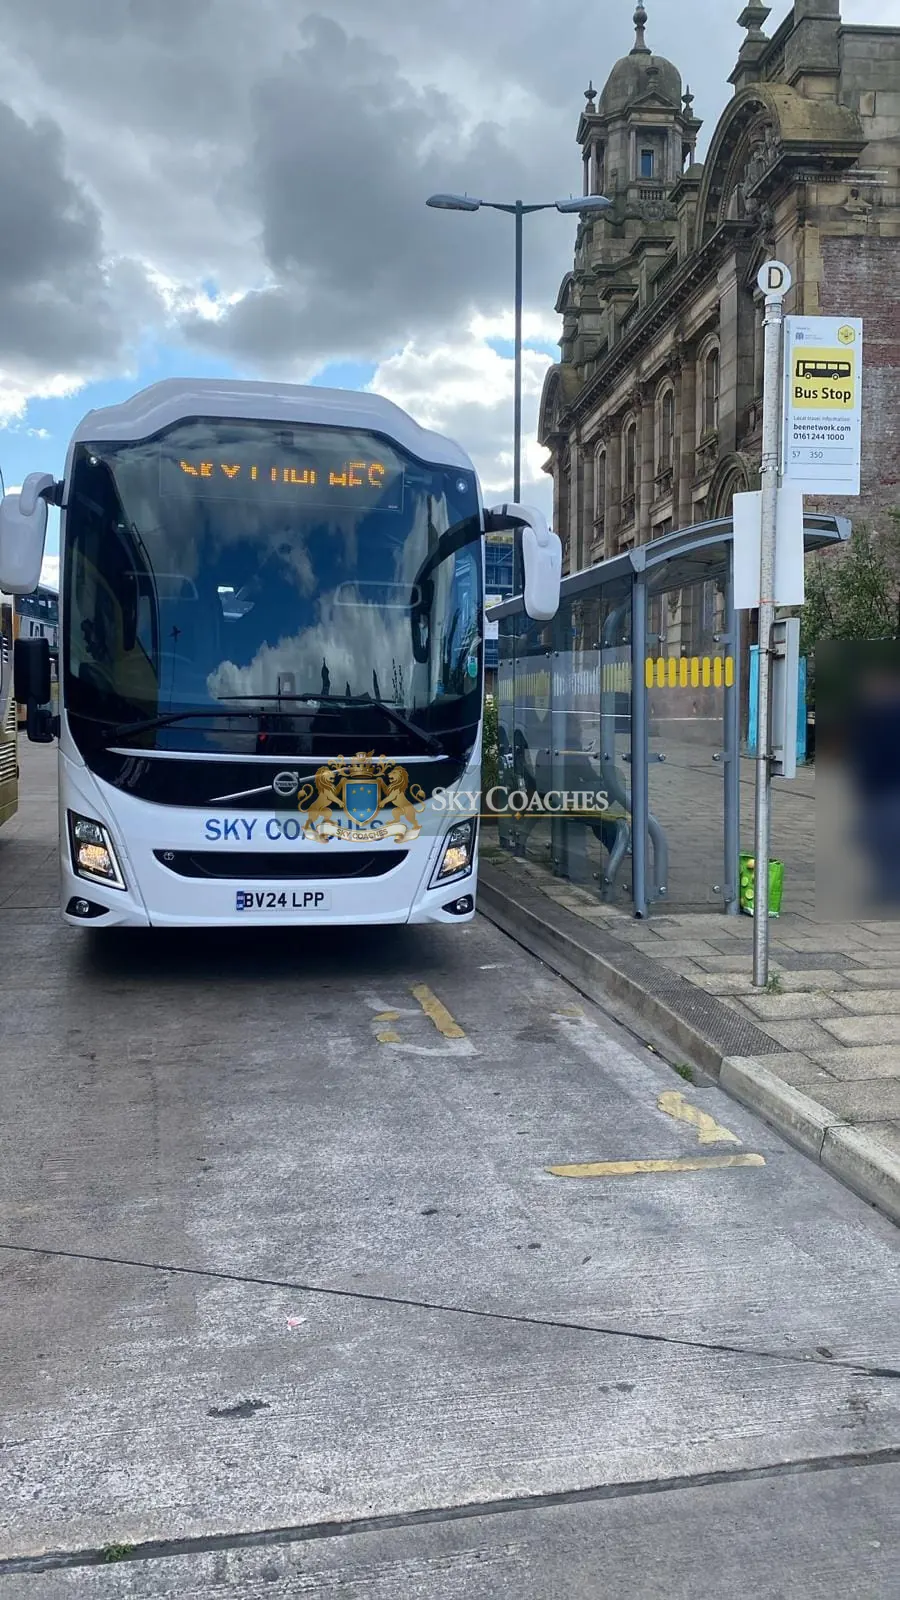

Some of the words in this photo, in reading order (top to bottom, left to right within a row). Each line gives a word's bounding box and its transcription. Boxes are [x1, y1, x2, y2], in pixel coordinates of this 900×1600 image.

[767, 266, 784, 289] D
[794, 386, 818, 399] Bus
[821, 387, 851, 404] Stop
[793, 423, 852, 432] beenetwork.com
[793, 432, 810, 440] 0161
[827, 433, 845, 441] 1000
[792, 450, 801, 458] 57
[809, 451, 824, 459] 350
[204, 818, 258, 841] SKY
[243, 892, 288, 908] BV24
[292, 892, 325, 908] LPP
